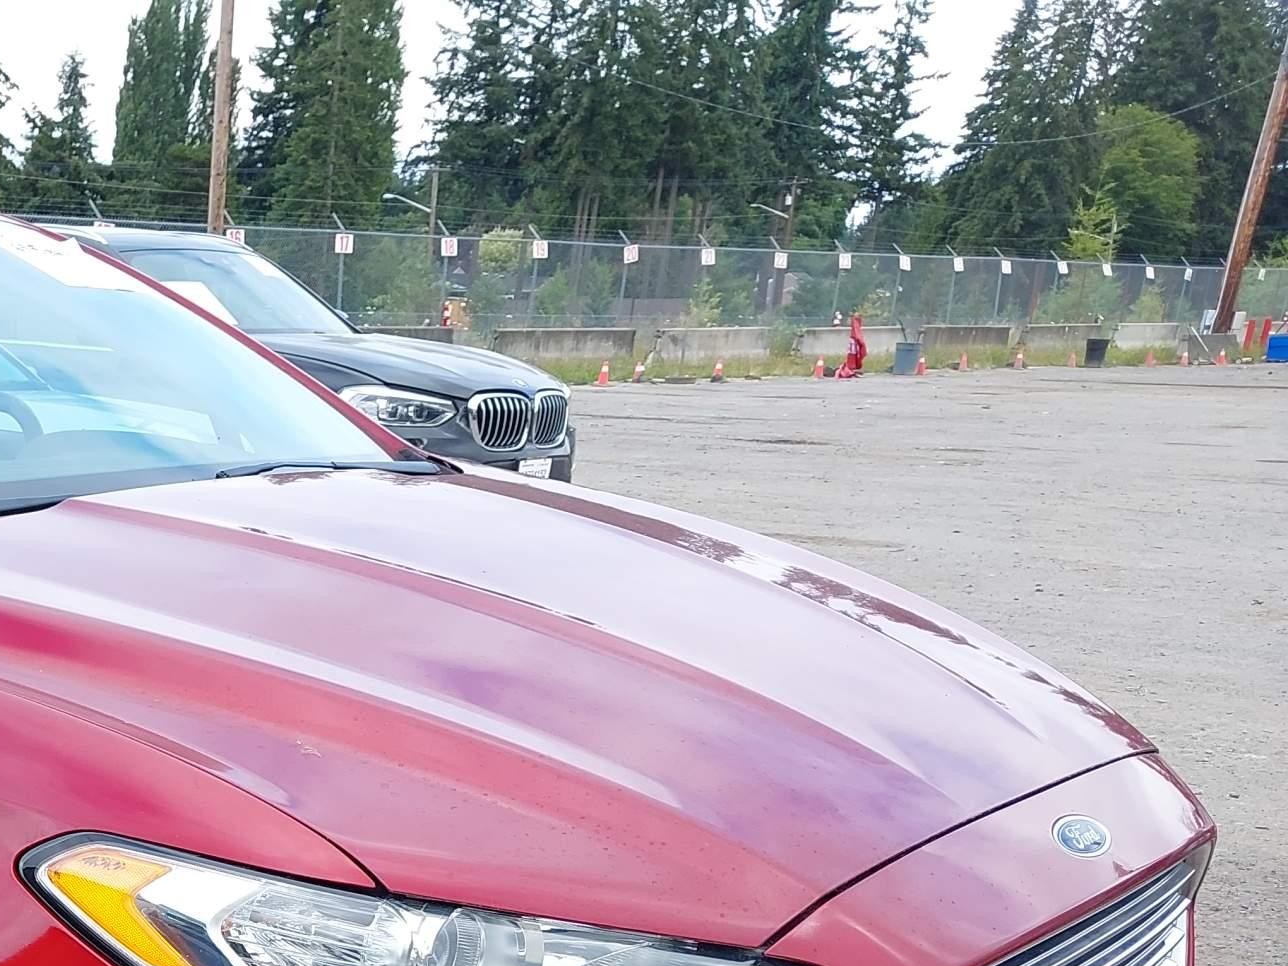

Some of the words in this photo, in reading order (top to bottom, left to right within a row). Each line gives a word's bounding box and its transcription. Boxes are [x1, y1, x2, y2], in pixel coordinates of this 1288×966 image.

[230, 230, 241, 243] 16
[339, 235, 350, 252] 17
[444, 239, 456, 255] 18
[535, 242, 546, 257] 19
[626, 246, 638, 262] 20
[1065, 824, 1101, 848] Ford
